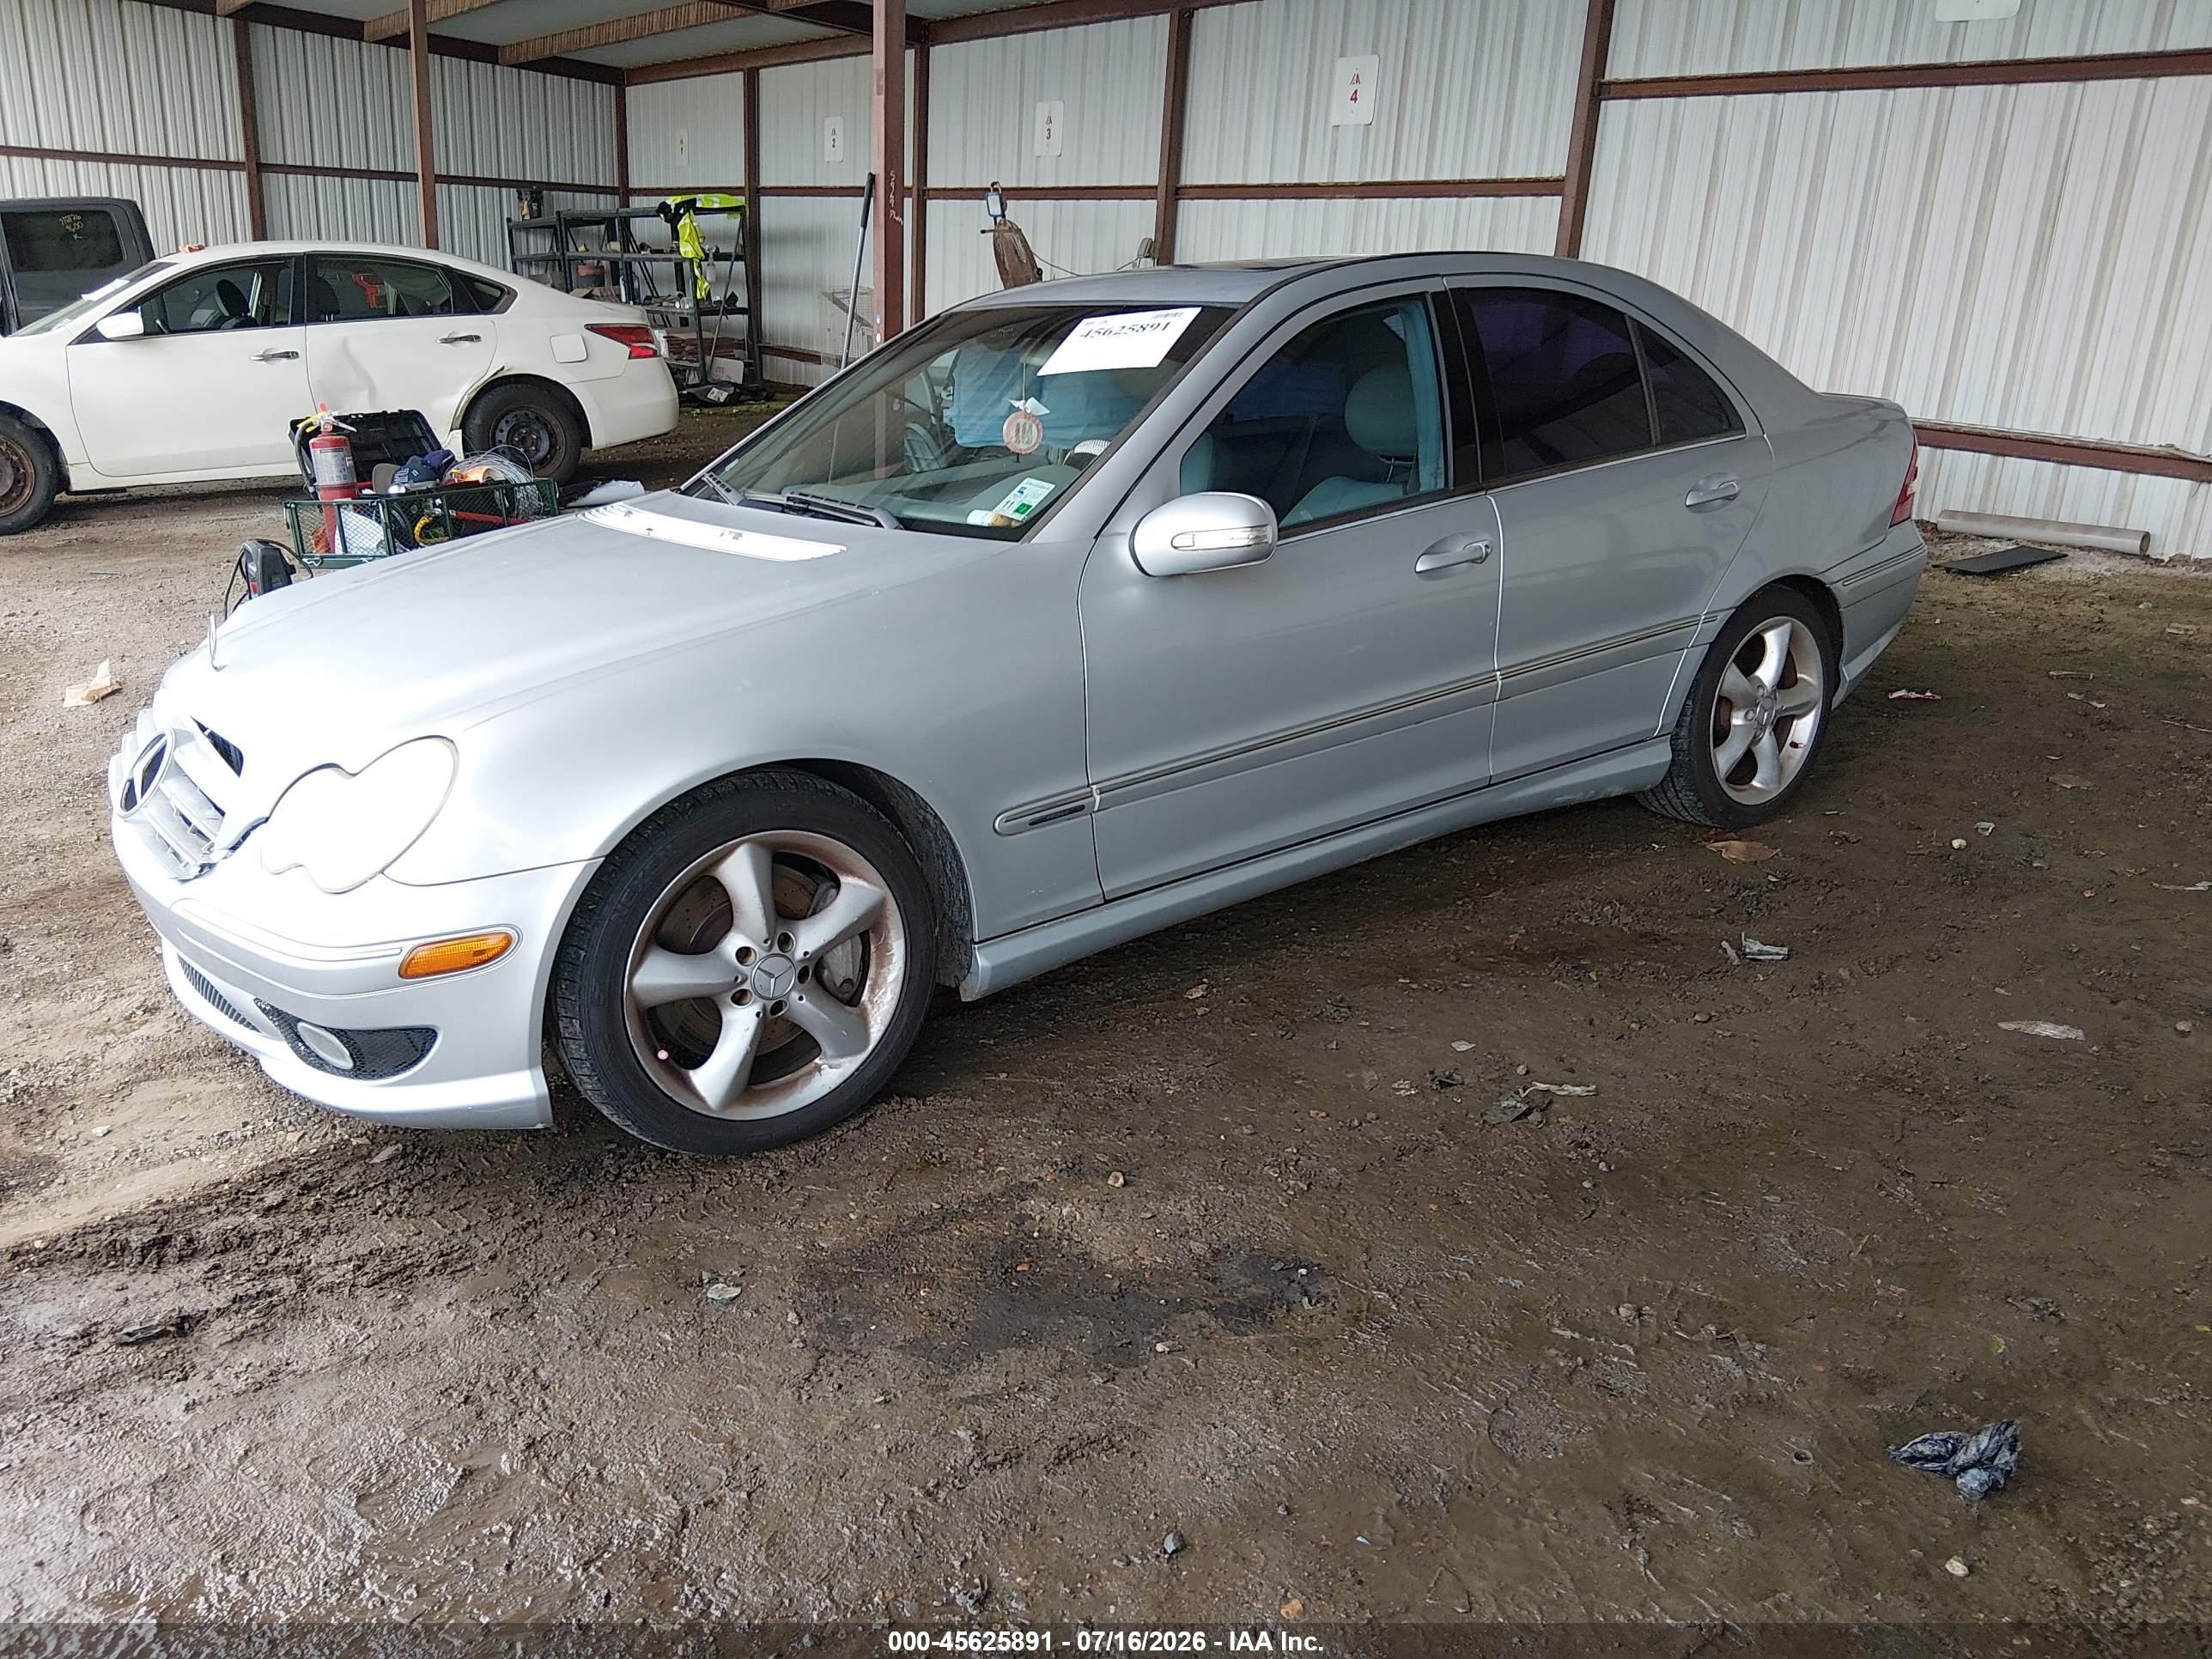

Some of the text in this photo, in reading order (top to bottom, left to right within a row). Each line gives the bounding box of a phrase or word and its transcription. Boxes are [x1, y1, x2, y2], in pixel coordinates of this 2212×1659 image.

[1350, 88, 1358, 104] 4
[1045, 128, 1052, 141] 3
[1080, 321, 1171, 339] 45625891
